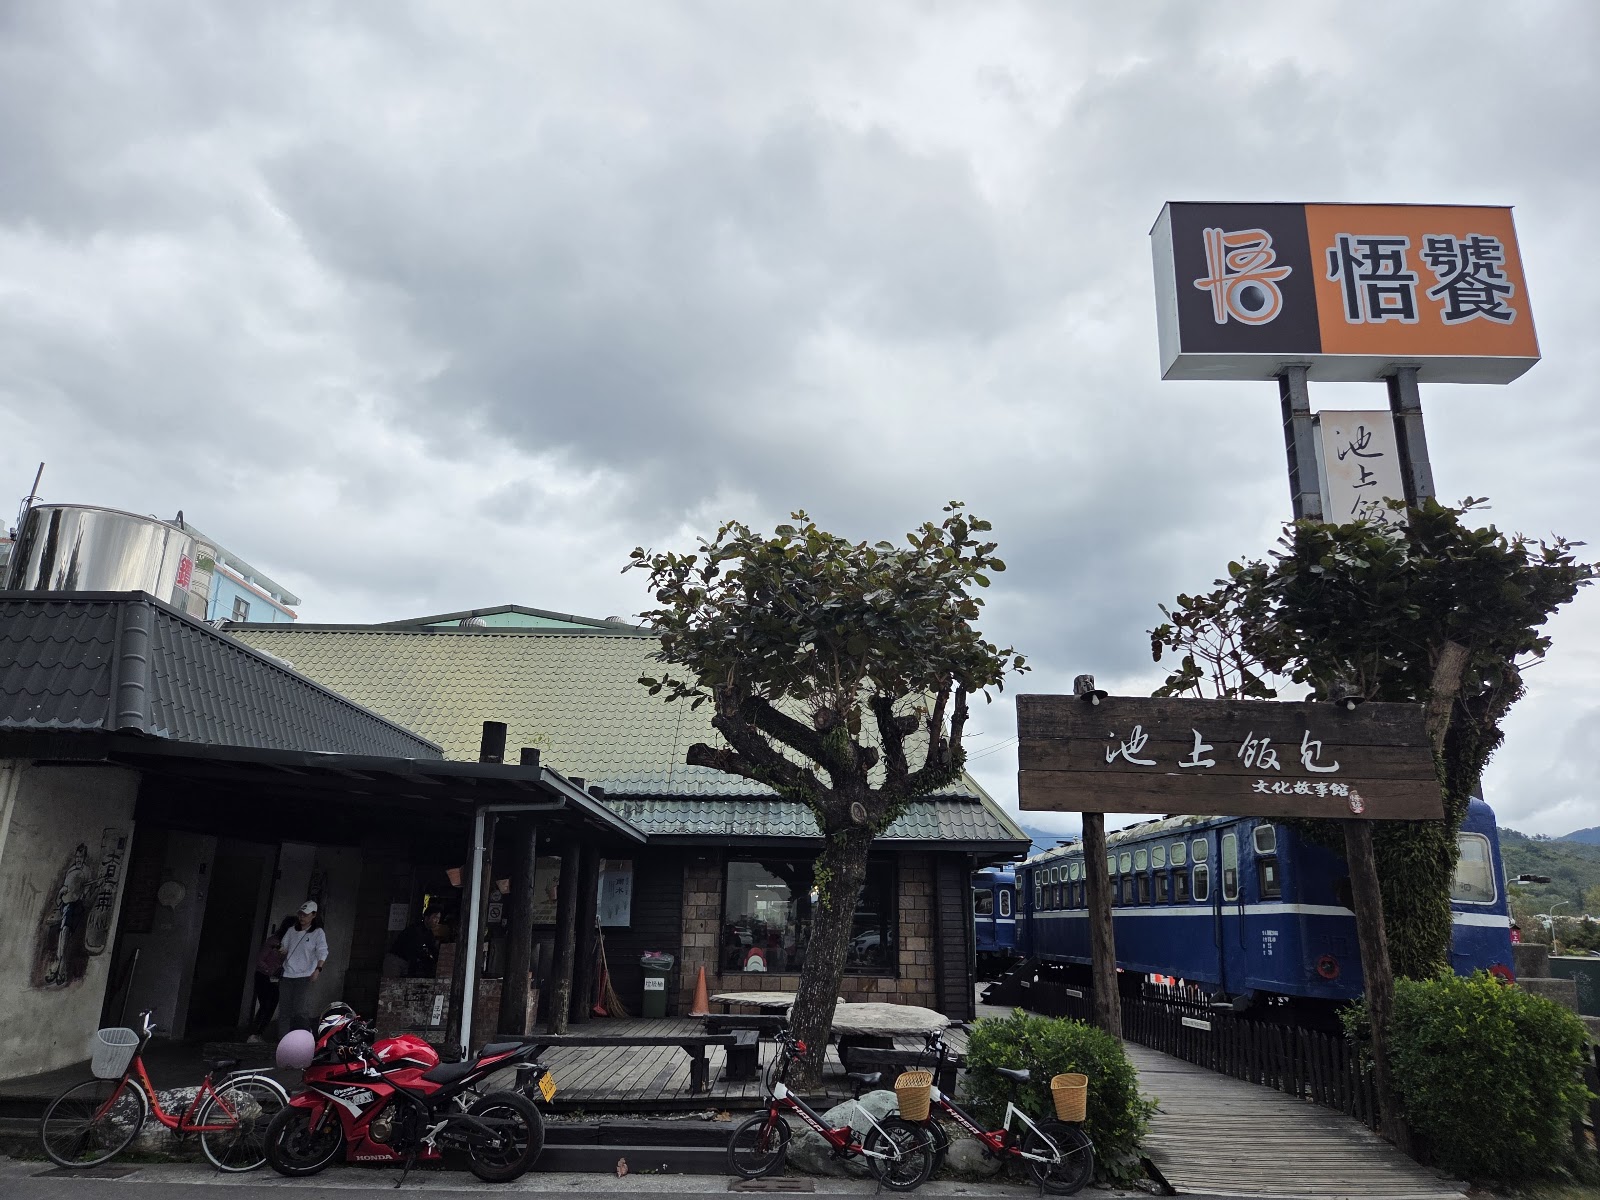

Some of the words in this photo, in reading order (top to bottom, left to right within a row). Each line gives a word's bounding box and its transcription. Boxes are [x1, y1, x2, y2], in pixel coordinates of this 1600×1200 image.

[1327, 233, 1516, 325] 悟饕
[1106, 724, 1340, 773] 池上飯包
[1252, 778, 1350, 798] 文化故事館
